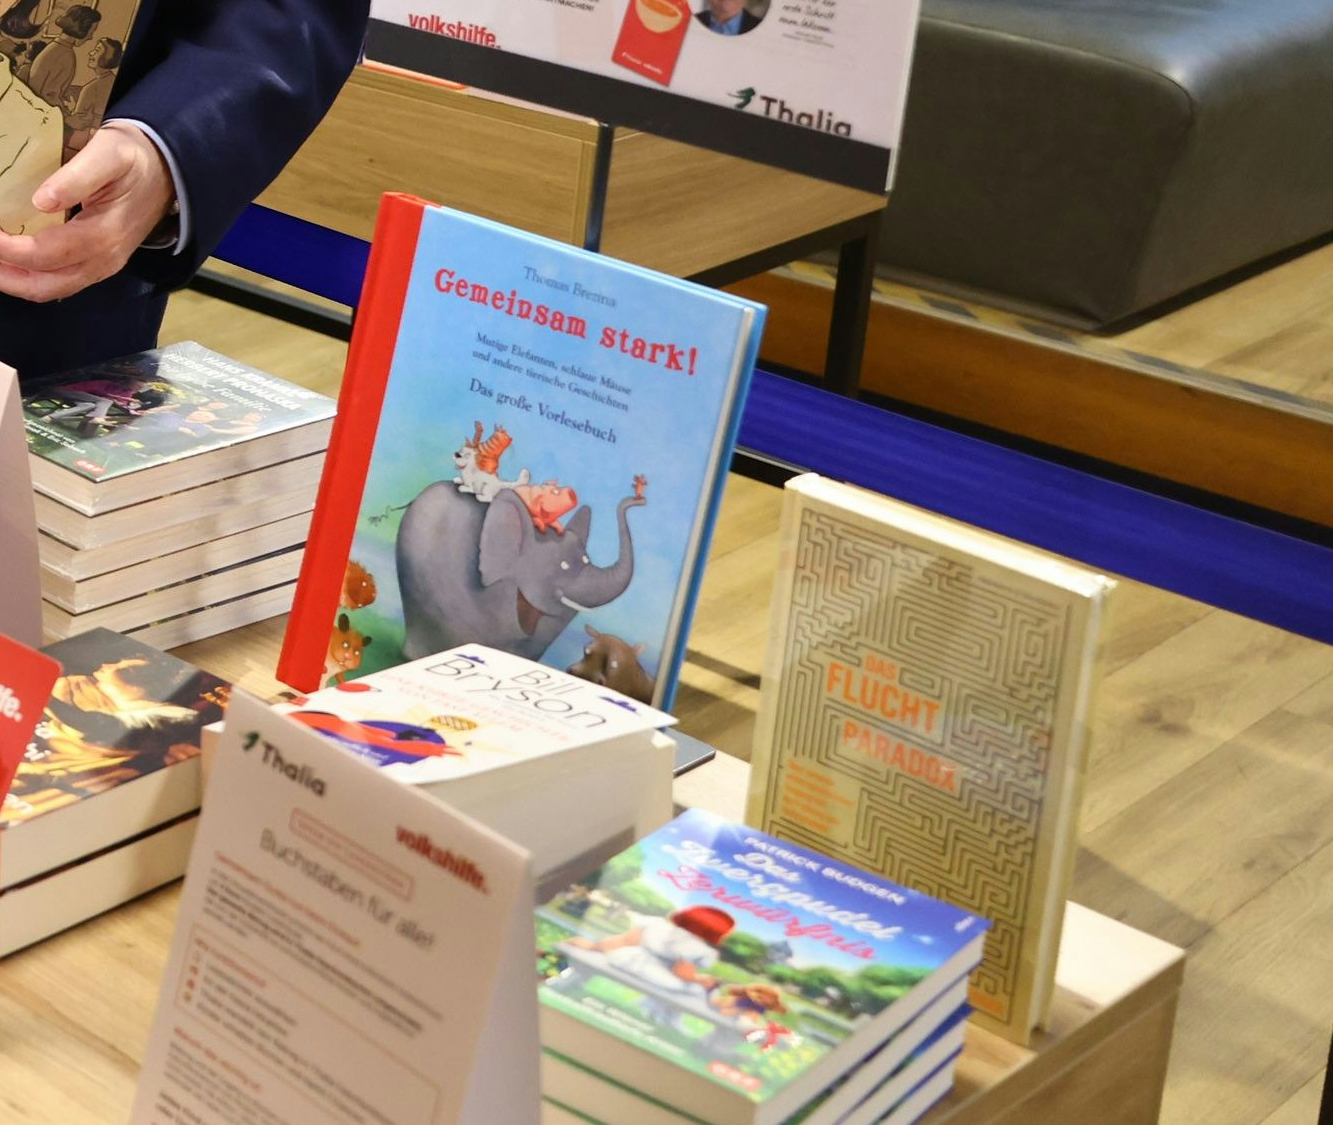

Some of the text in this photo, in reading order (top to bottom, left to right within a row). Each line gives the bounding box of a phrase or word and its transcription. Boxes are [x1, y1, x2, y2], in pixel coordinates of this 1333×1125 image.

[760, 95, 853, 138] Thalia
[524, 266, 571, 293] Thomas
[435, 268, 697, 375] Gemeinsam stark!
[473, 350, 629, 412] und andere tierische Geschichten
[476, 332, 632, 395] Mutige Elefanten, schlaue Mäuse
[469, 378, 617, 444] Das große Vorlesebuch
[425, 658, 607, 729] Bryson
[512, 669, 583, 697] Bill
[826, 662, 940, 734] FLUCHT
[865, 655, 896, 679] DAS
[260, 741, 328, 797] Thalia
[842, 721, 956, 793] PARADOX
[744, 837, 907, 905] PATRICK BUDGEN
